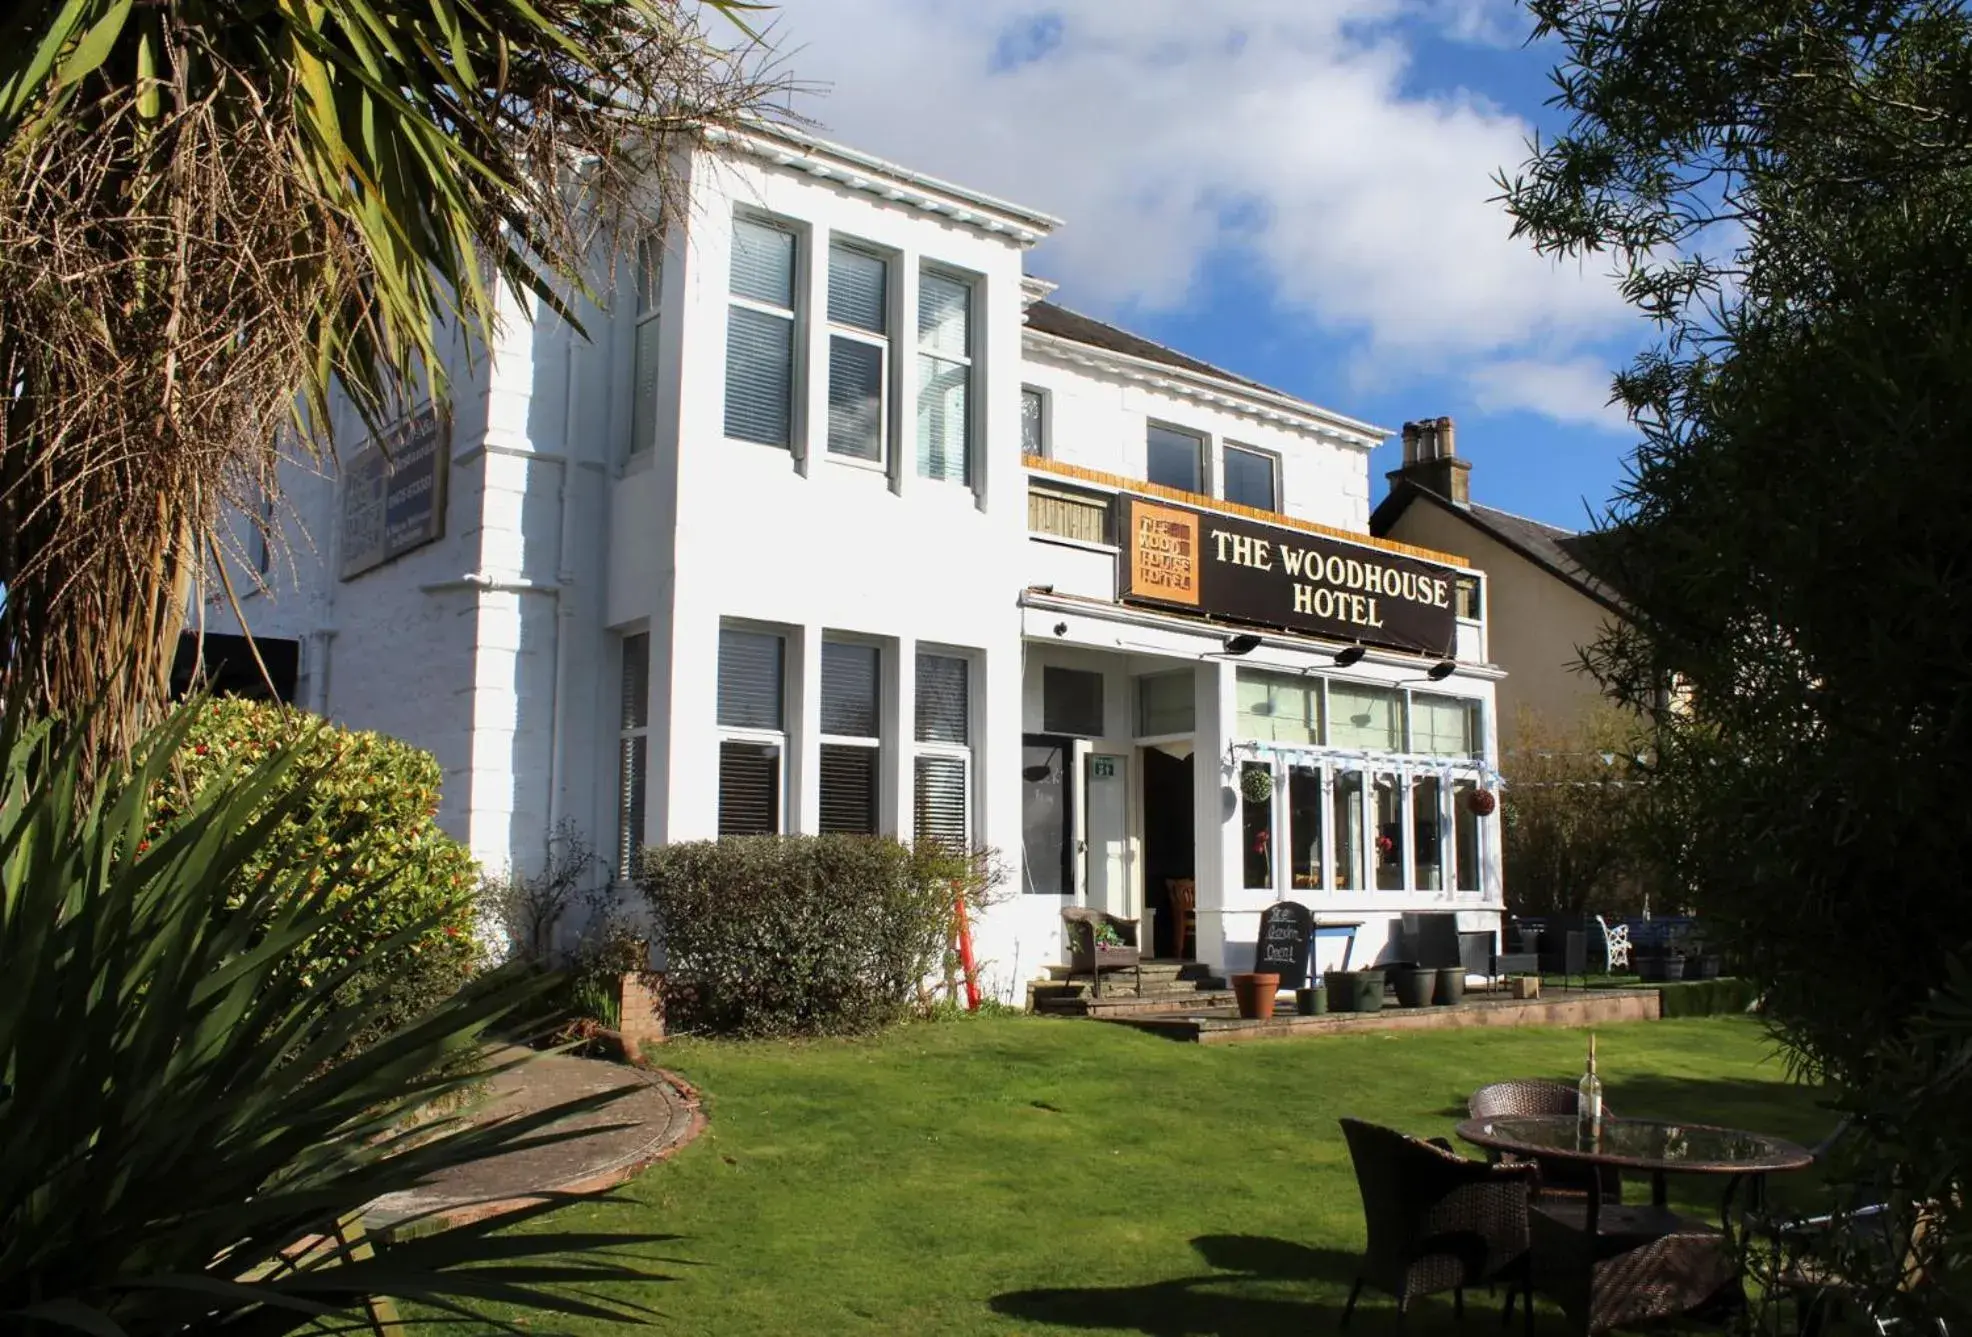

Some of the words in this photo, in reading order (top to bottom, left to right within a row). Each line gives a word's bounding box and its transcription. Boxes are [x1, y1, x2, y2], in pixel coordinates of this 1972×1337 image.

[1139, 533, 1181, 554] WOOD
[1140, 550, 1191, 573] HOUSE
[1211, 529, 1272, 571] THE
[1279, 544, 1449, 609] WOODHOUSE
[1140, 567, 1191, 591] HOTEL
[1293, 583, 1384, 628] HOTEL
